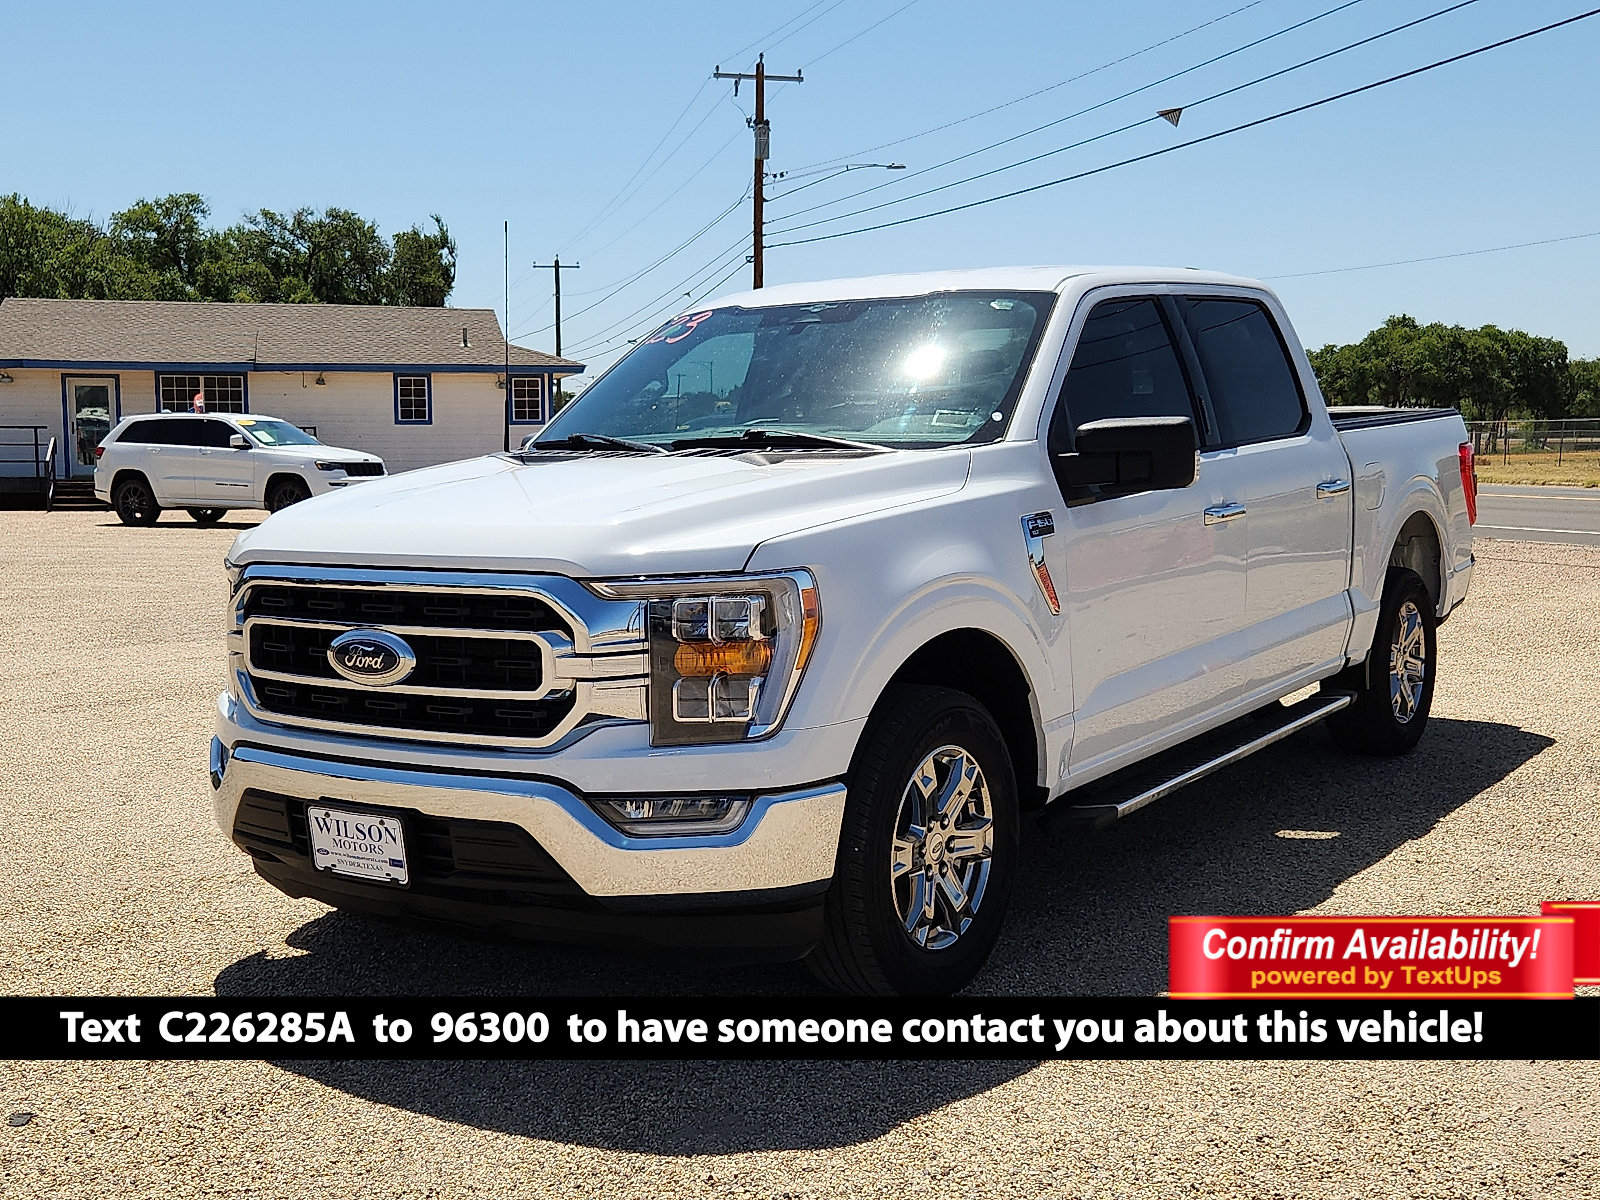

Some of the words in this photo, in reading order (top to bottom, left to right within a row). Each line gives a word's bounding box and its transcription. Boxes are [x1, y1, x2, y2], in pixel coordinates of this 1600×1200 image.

[344, 644, 385, 669] Ford
[313, 816, 398, 846] WILSON
[332, 838, 385, 855] MOTORS
